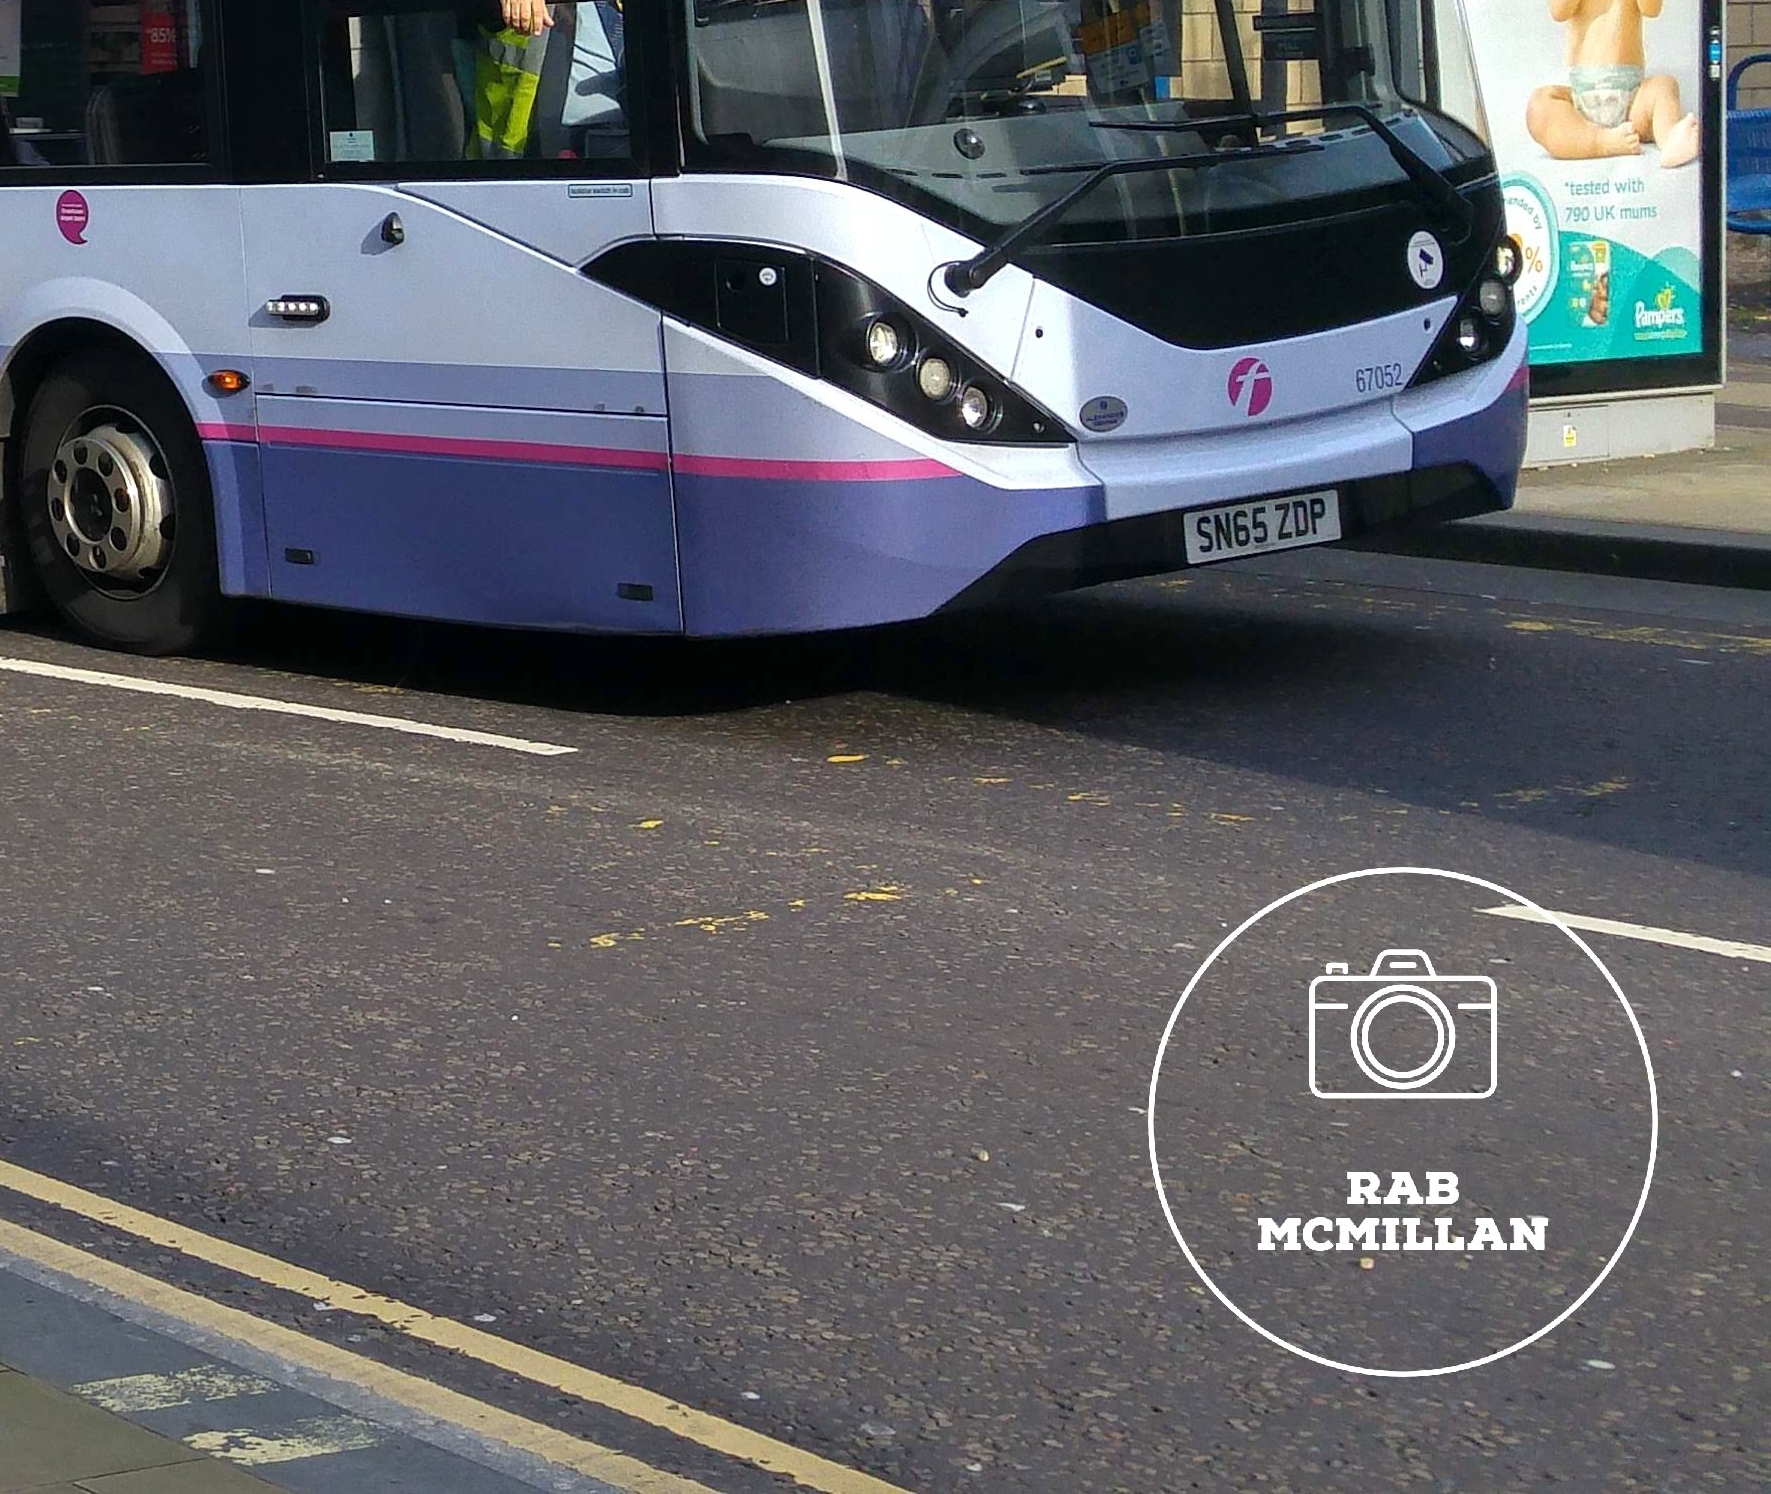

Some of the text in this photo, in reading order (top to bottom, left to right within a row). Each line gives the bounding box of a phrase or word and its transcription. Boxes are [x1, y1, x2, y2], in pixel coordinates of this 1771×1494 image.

[1615, 179, 1645, 194] with
[1565, 206, 1658, 222] 790 UK mums
[1635, 301, 1685, 328] Pampers
[1356, 362, 1403, 393] 67052
[1196, 497, 1326, 553] SN65 ZDP
